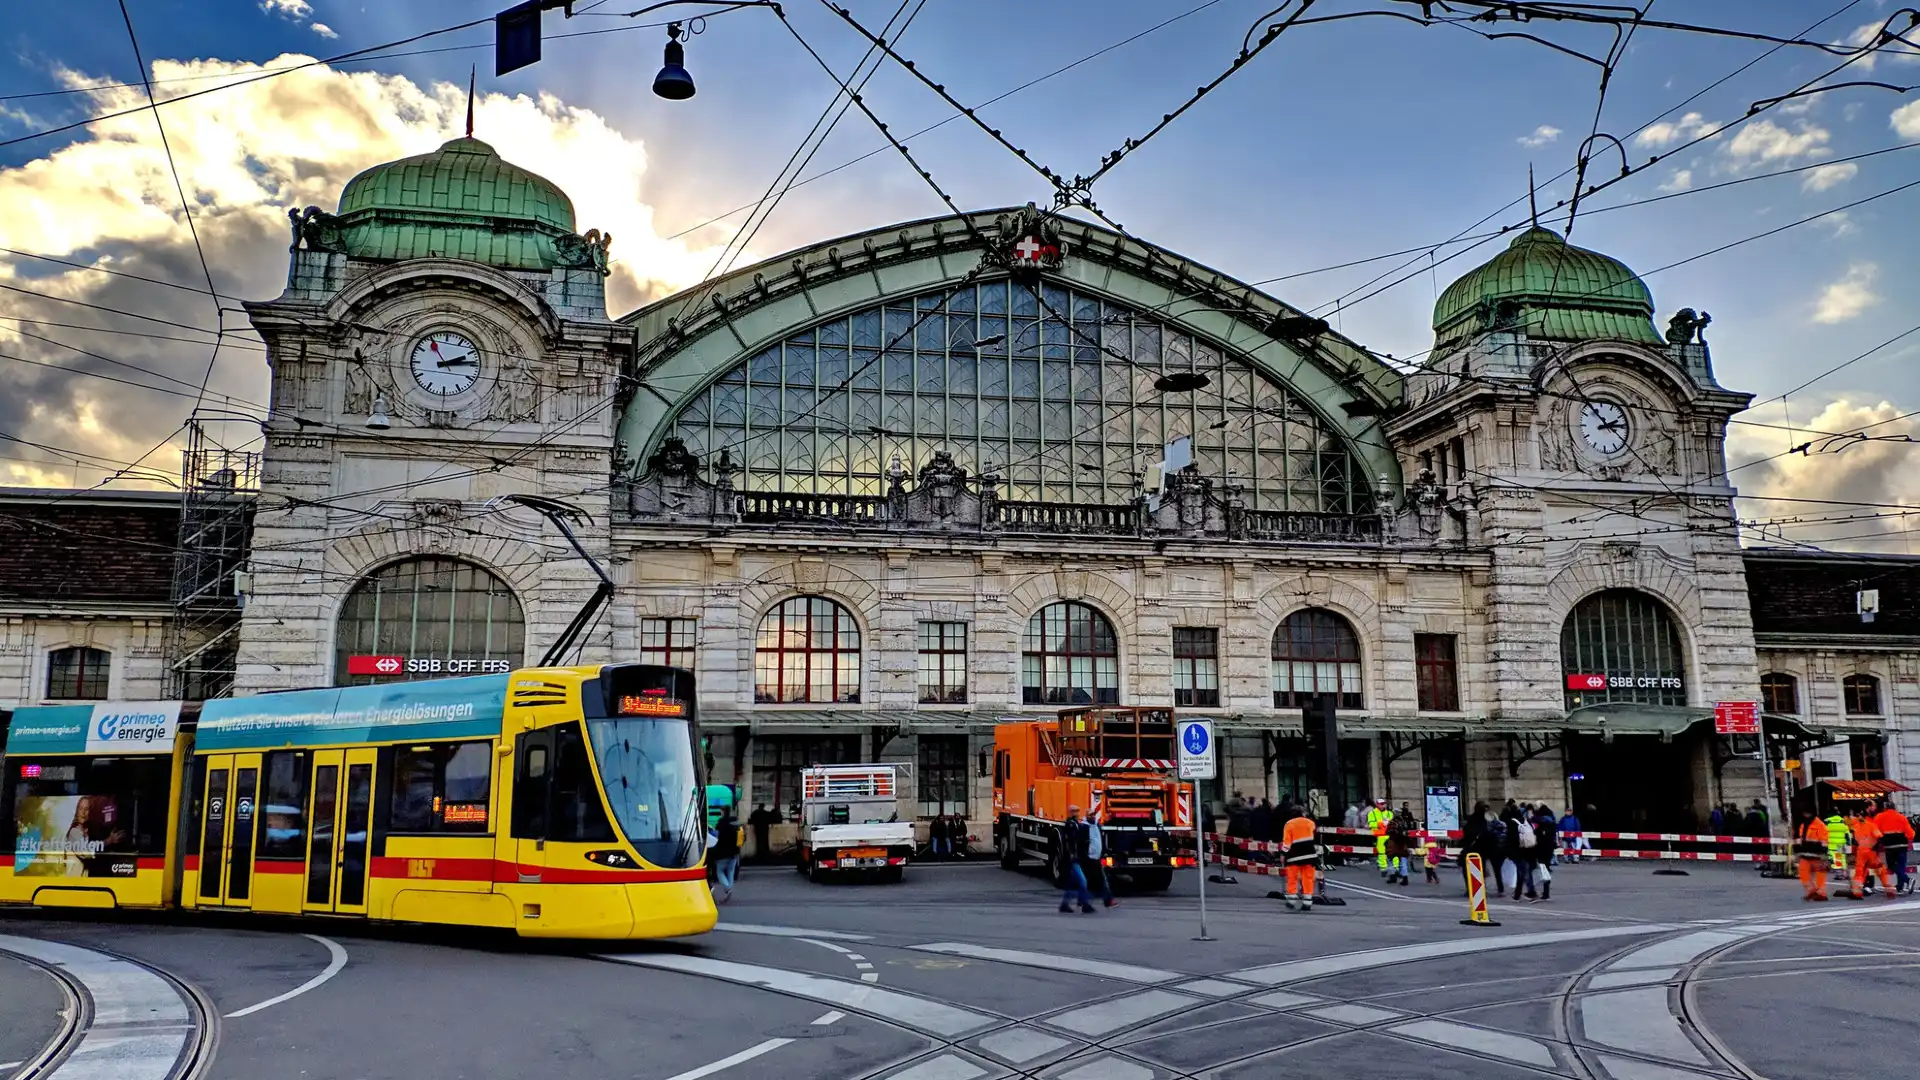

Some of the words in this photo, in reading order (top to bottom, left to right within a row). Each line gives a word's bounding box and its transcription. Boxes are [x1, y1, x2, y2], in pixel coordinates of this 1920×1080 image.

[408, 659, 441, 673] SBB
[448, 659, 477, 673] CFF
[482, 659, 510, 673] FFS
[1609, 676, 1633, 688] SBB
[1637, 677, 1658, 688] CFF
[1661, 678, 1681, 689] FFS
[120, 712, 166, 727] primeo
[366, 702, 474, 724] Energielösungen
[15, 725, 82, 737] primeo-energie.ch
[118, 725, 166, 743] energie
